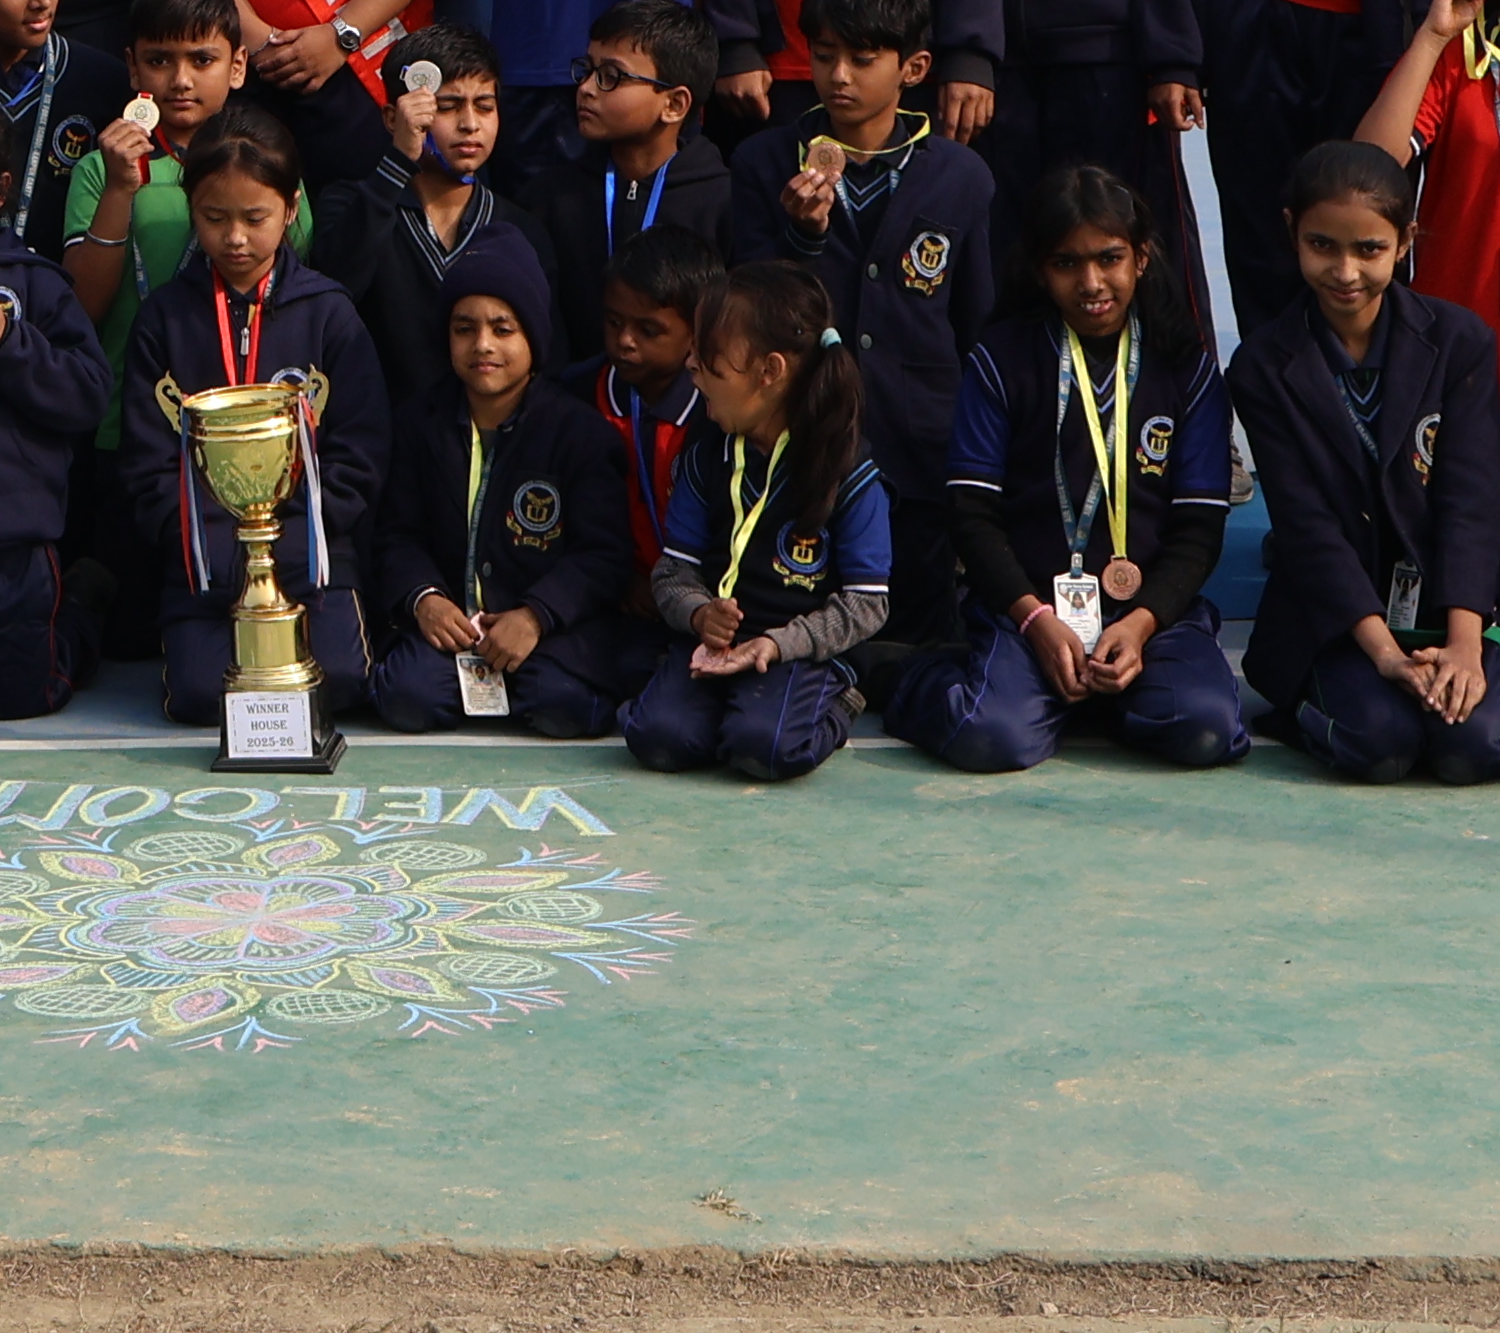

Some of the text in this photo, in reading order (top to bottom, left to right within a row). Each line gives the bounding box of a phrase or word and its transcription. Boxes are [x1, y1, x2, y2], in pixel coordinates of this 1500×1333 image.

[246, 703, 290, 714] WINNER
[250, 719, 288, 731] HOUSE
[246, 736, 294, 748] 2025-26
